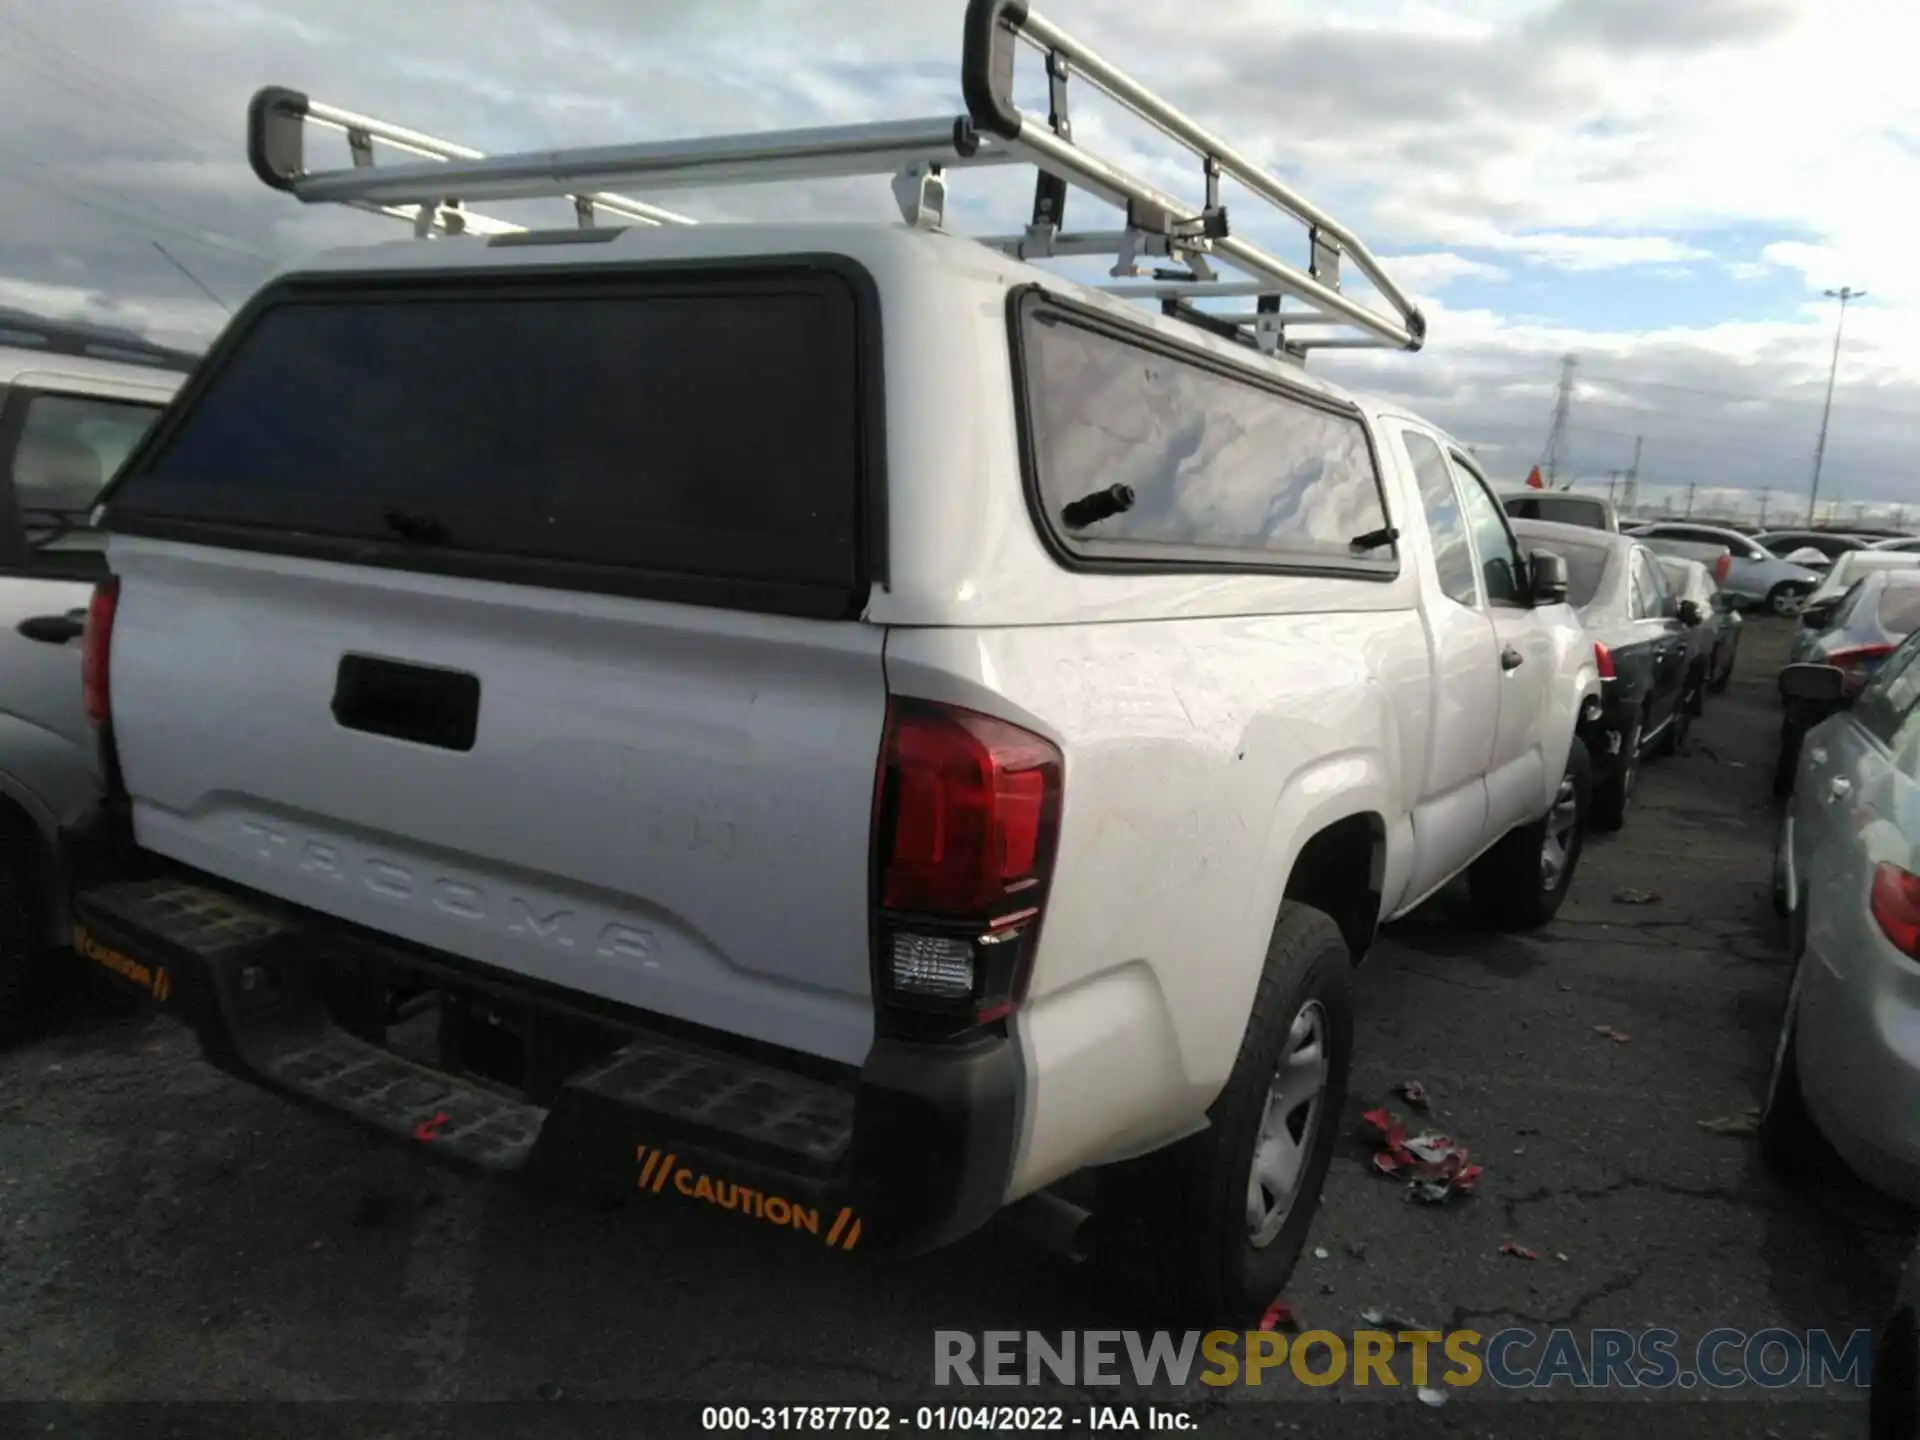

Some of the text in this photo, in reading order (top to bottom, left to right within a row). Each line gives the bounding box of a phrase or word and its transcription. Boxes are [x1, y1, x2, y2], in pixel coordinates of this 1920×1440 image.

[239, 818, 662, 970] TACOMA
[85, 938, 151, 986] CAUTION
[673, 1168, 820, 1235] CAUTION
